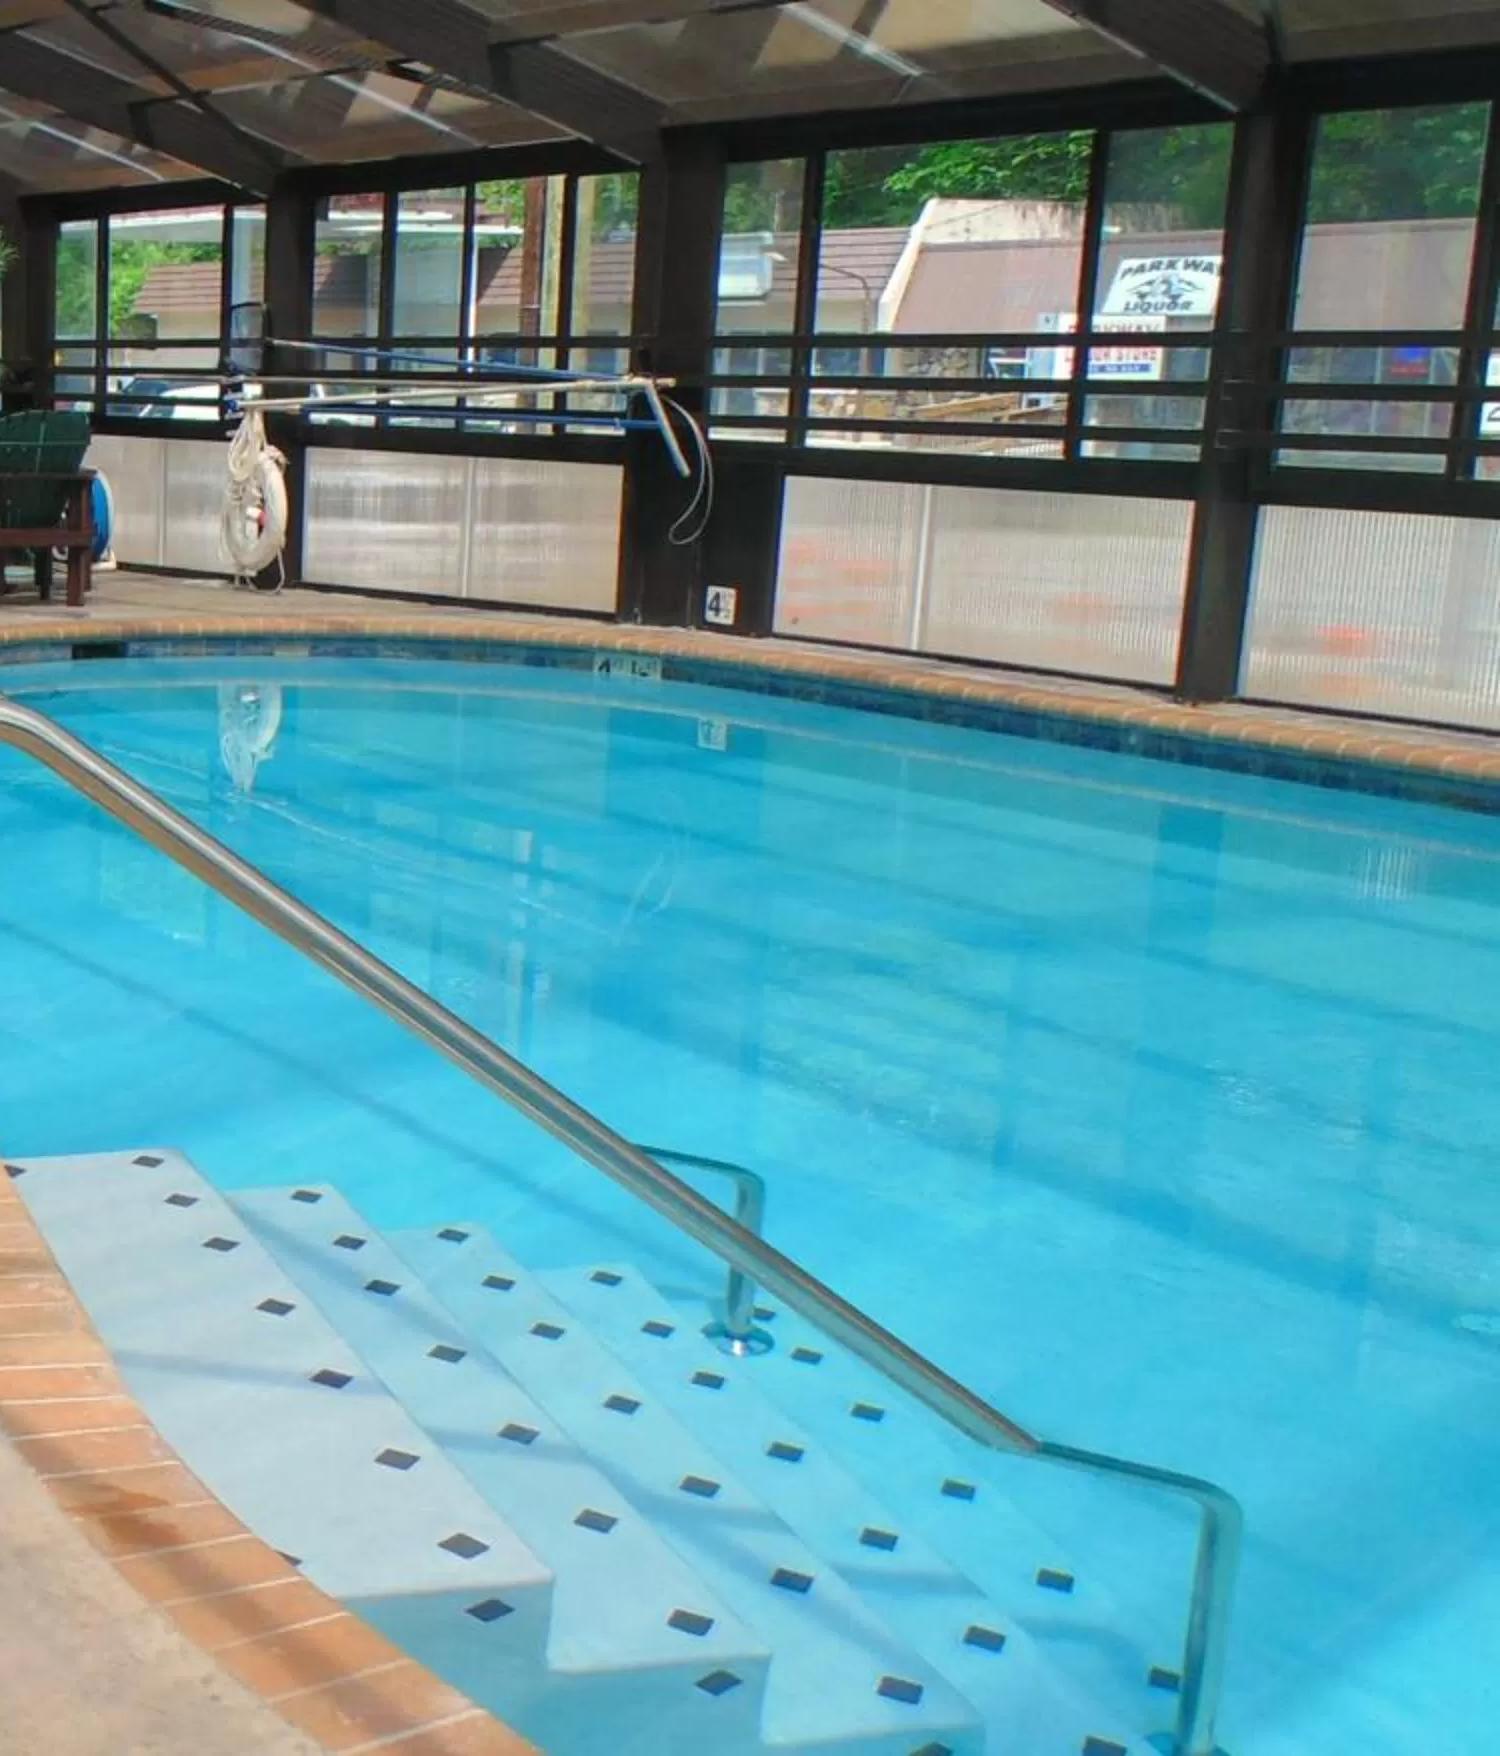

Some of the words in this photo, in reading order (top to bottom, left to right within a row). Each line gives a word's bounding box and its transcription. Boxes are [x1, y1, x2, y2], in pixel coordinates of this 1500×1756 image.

[1120, 259, 1222, 280] PARKWA
[1123, 301, 1194, 313] LIQUOR
[708, 591, 723, 617] 4
